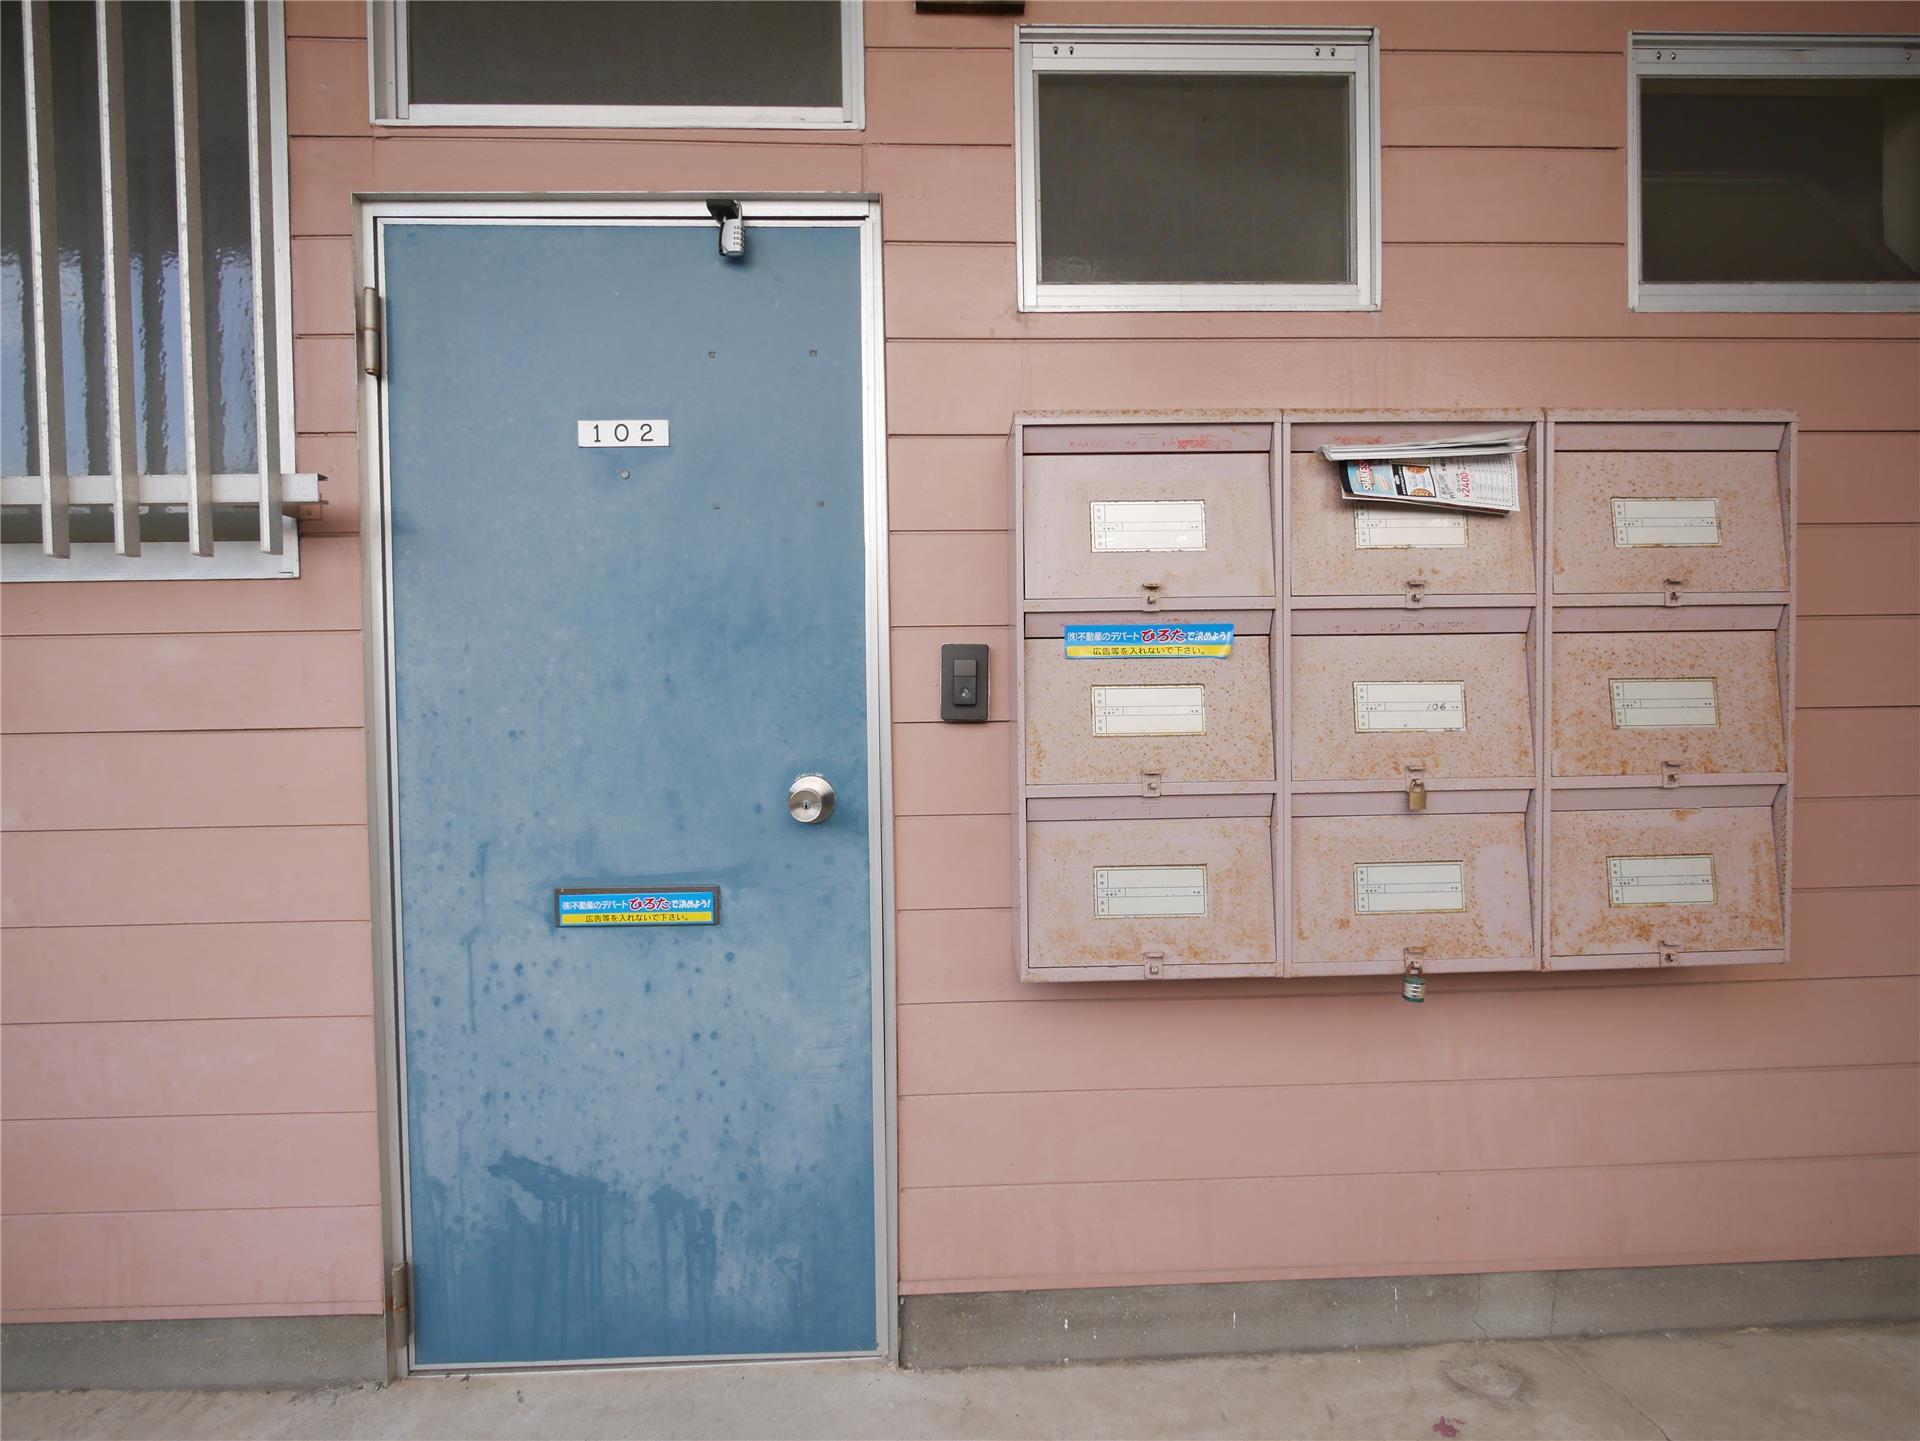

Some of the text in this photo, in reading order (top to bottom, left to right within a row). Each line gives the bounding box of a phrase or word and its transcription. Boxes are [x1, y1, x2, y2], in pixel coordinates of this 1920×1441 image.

[593, 423, 654, 443] 102
[1093, 645, 1206, 656] 広告等を入れないで下さい。
[1426, 702, 1447, 711] 106
[585, 913, 689, 923] 広告等を入れないで下さい。
